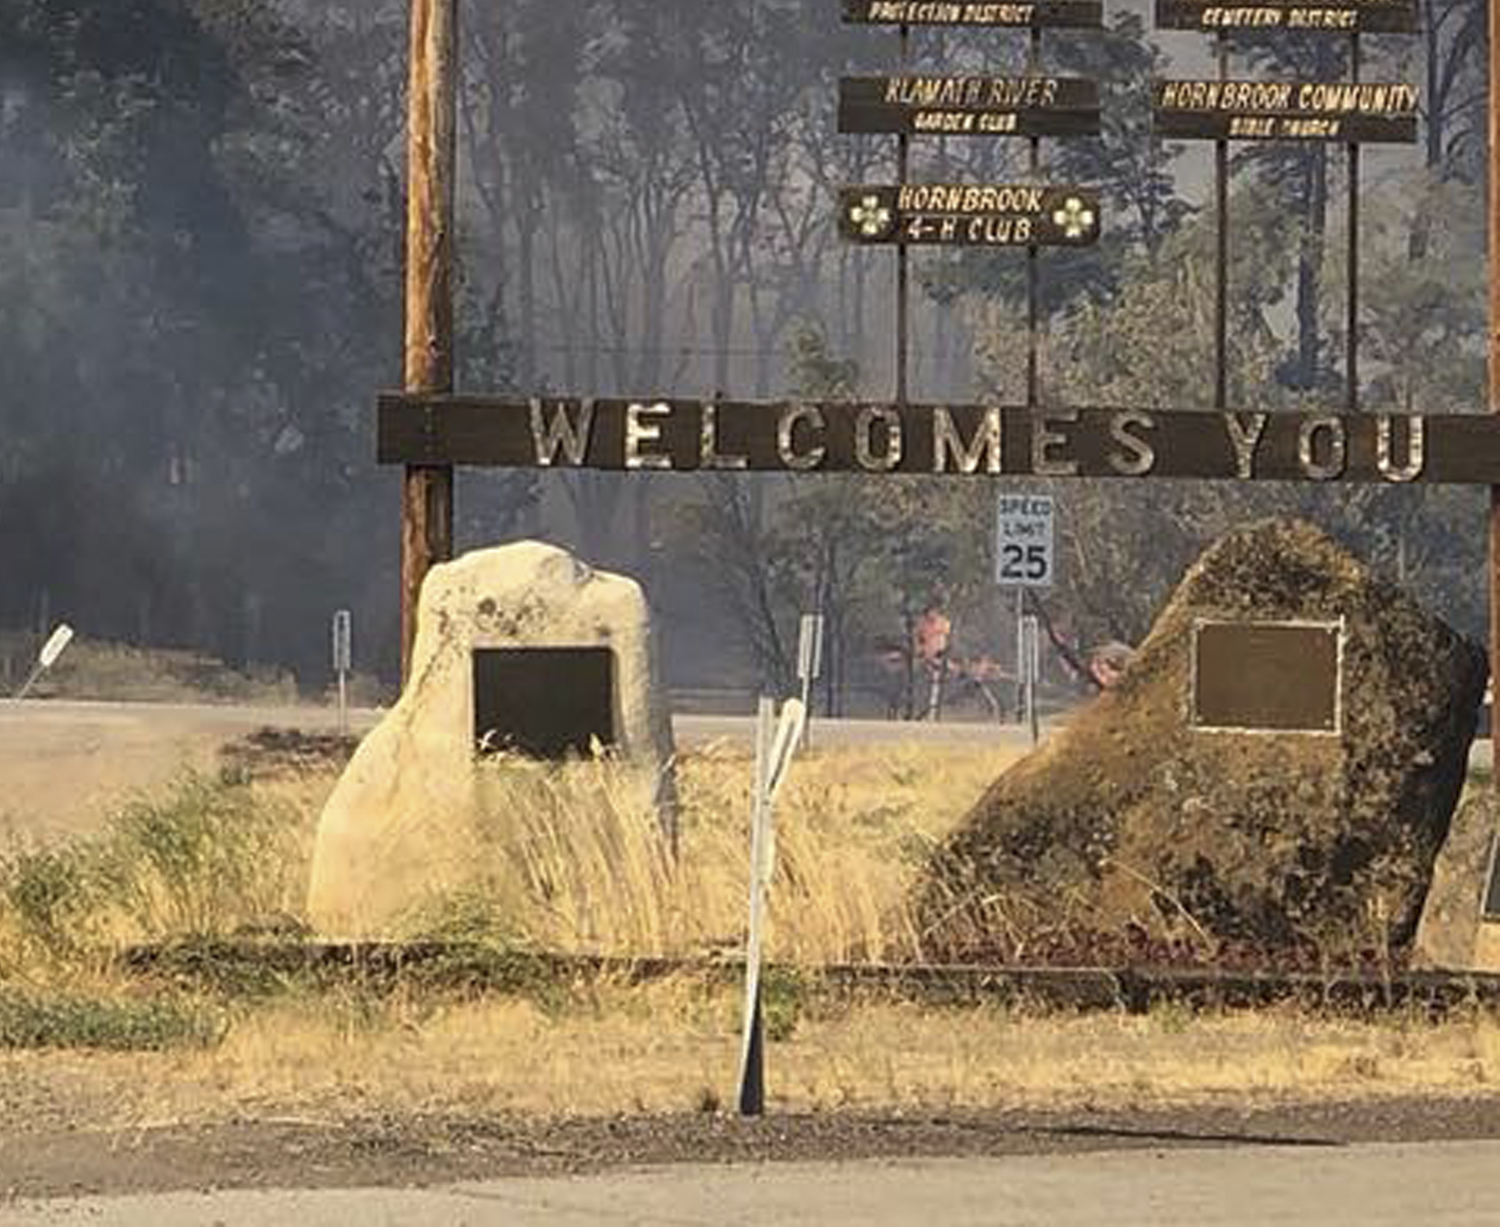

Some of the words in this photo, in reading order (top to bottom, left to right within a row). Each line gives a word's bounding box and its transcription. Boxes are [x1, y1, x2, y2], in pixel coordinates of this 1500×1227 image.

[884, 77, 982, 105] KLAMATH
[988, 77, 1058, 107] RIVER
[1162, 81, 1293, 111] HORNBROOK
[1299, 83, 1419, 112] COMMUNITY
[899, 185, 1044, 212] HORNBROOK
[967, 217, 1033, 243] CLUB
[528, 398, 1158, 476] WELCOMES
[1225, 411, 1428, 483] YOU
[1000, 498, 1051, 516] SPEED
[1003, 521, 1045, 537] LIMIT
[1001, 544, 1048, 580] 25
